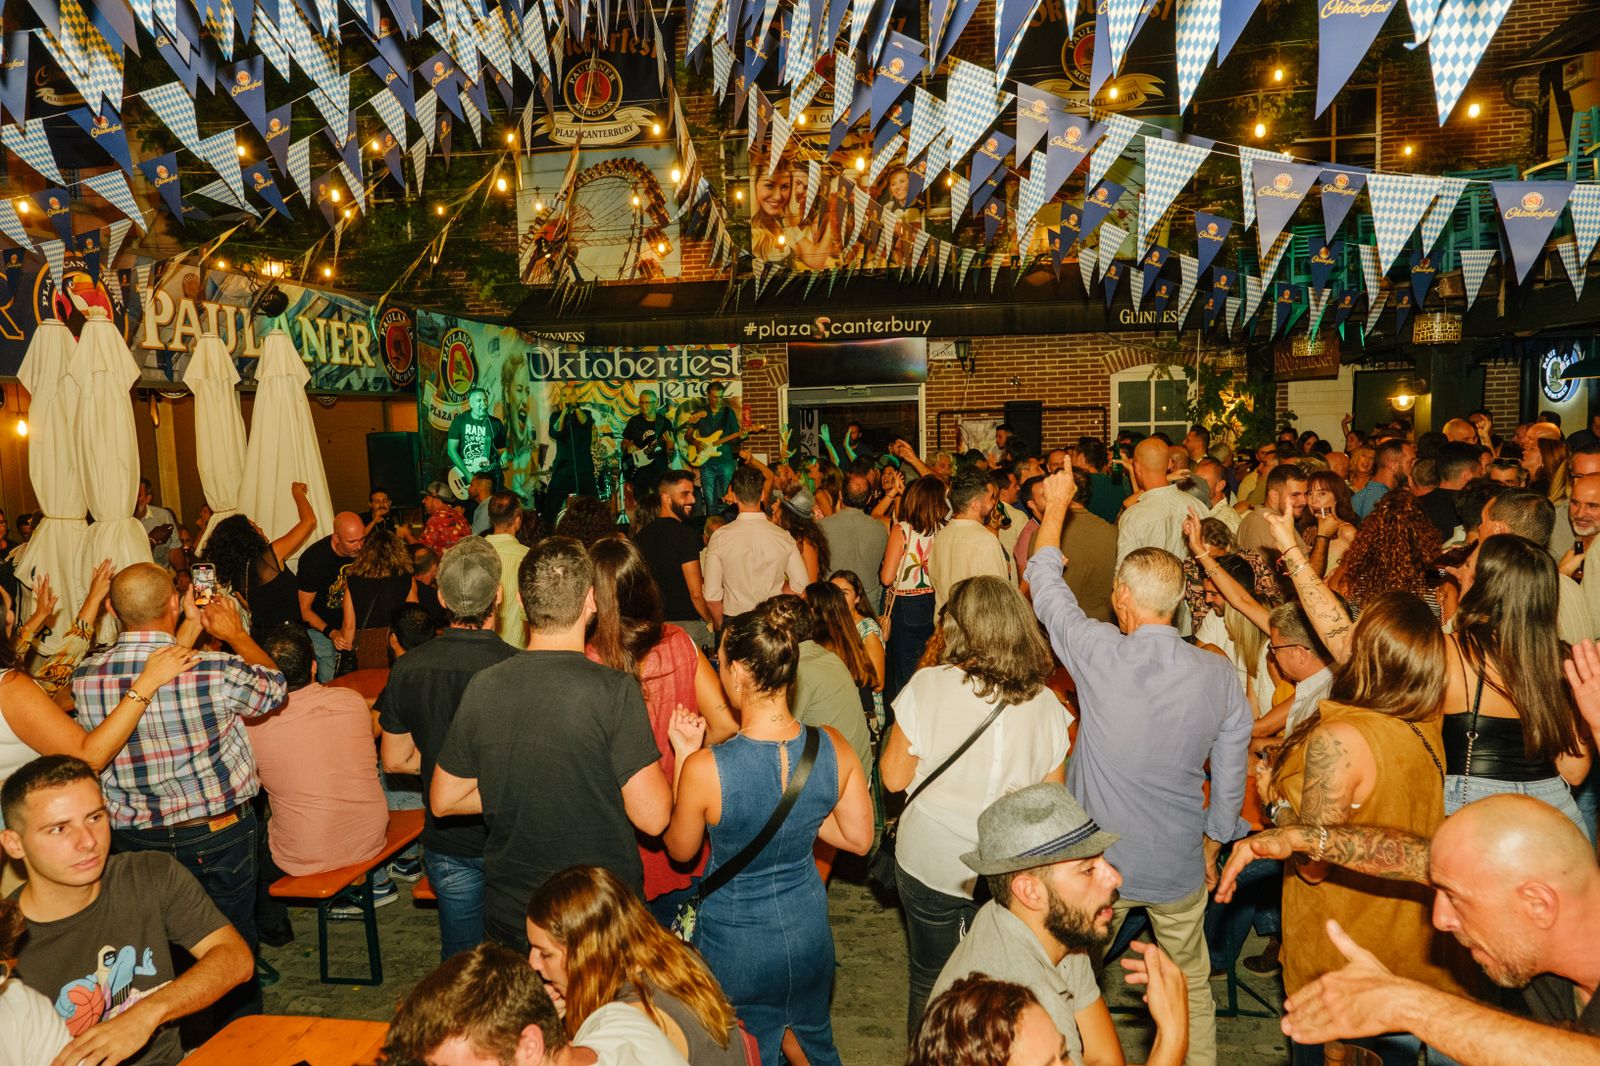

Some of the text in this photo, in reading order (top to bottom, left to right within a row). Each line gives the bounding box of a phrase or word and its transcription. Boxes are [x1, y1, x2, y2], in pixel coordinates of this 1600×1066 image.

[1320, 0, 1391, 19] Oktoberfest
[581, 123, 633, 138] CANTERBURY
[1050, 136, 1088, 153] Oktoberfest
[1257, 185, 1304, 200] Oktoberfest
[1322, 183, 1357, 196] Oktoberfest
[1504, 207, 1558, 220] Oktoberfest
[1119, 308, 1179, 325] GUINES
[743, 316, 932, 340] #plaza canterbury
[529, 343, 743, 380] Oktoberfest
